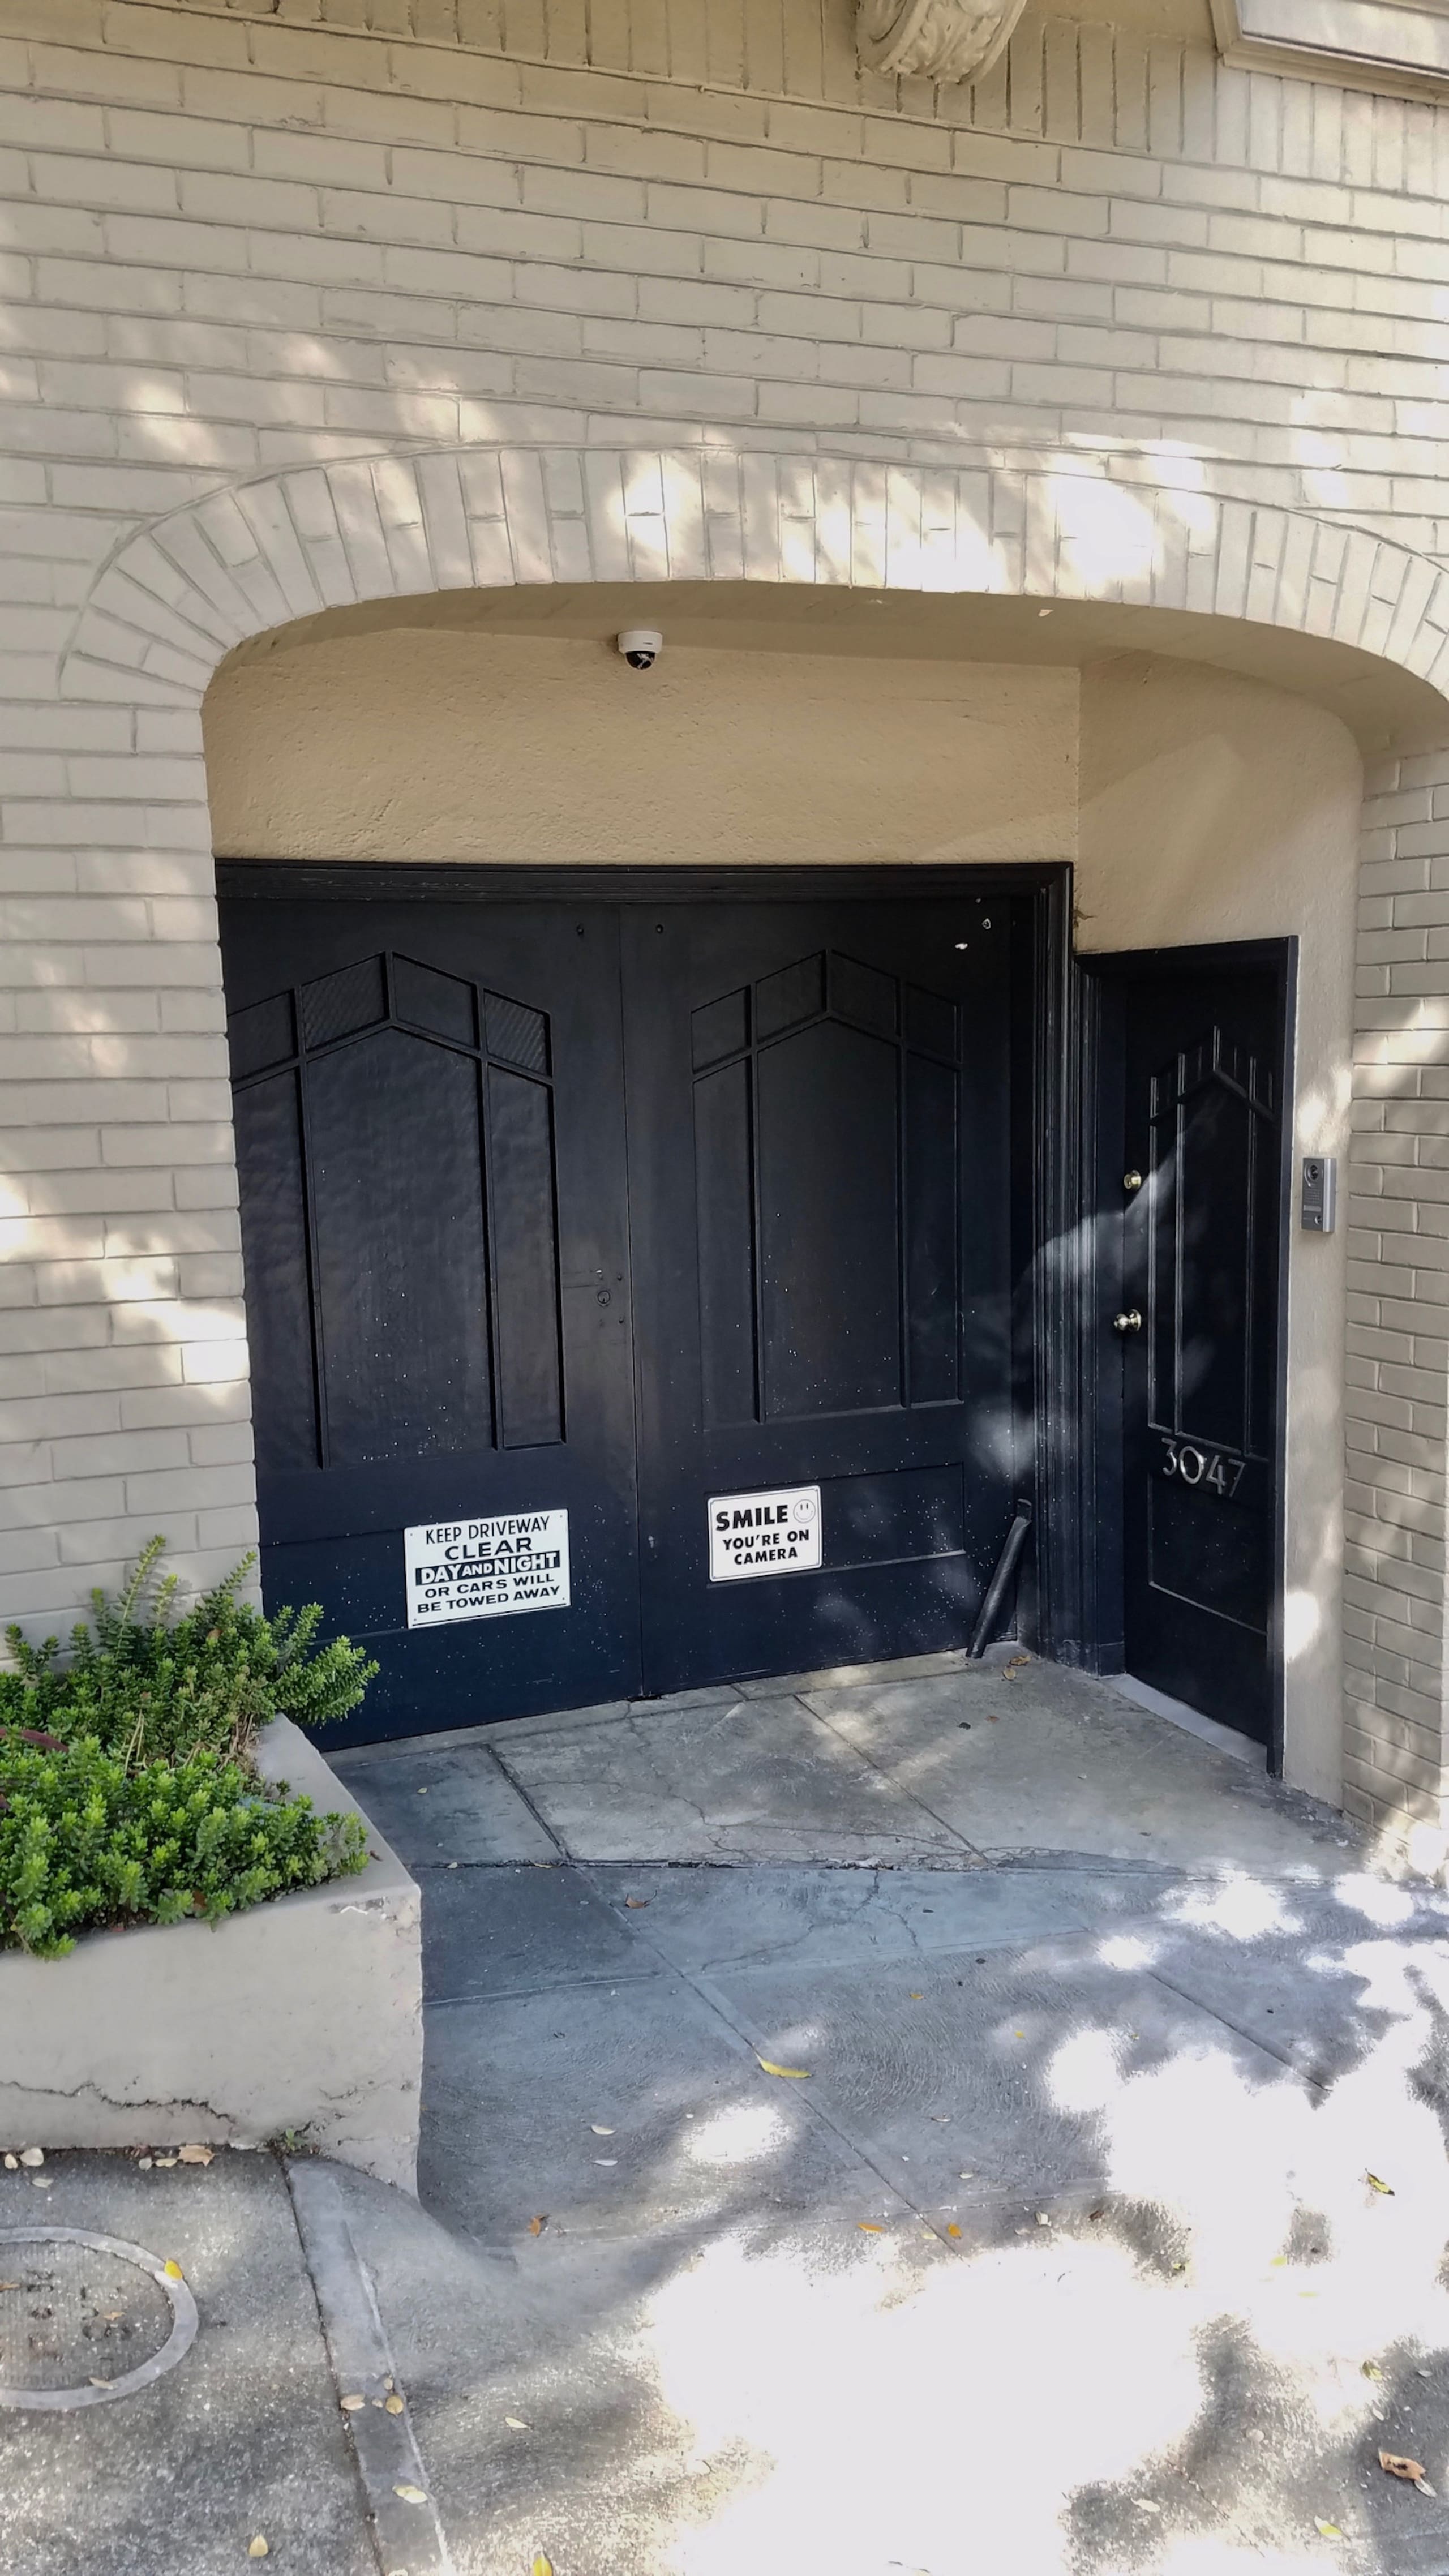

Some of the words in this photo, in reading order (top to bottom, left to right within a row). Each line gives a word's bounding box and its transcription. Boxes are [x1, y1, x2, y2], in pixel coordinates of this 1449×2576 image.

[1161, 1437, 1246, 1497] 3047
[426, 1527, 461, 1545] KEEP
[469, 1516, 550, 1539] DRIVEWAY
[715, 1504, 788, 1532] SMILE
[444, 1537, 531, 1561] CLEAR
[723, 1533, 780, 1551] YOU'RE
[787, 1529, 809, 1542] ON
[421, 1564, 461, 1585] DAY
[461, 1563, 494, 1576] AND
[494, 1553, 557, 1575] NIGHT
[734, 1547, 798, 1565] CAMERA
[417, 1602, 441, 1614] BE
[445, 1593, 508, 1610] TOWED
[513, 1585, 560, 1601] AWAY
[425, 1587, 450, 1598] OR
[457, 1579, 507, 1594] CARS
[513, 1574, 555, 1586] WILL
